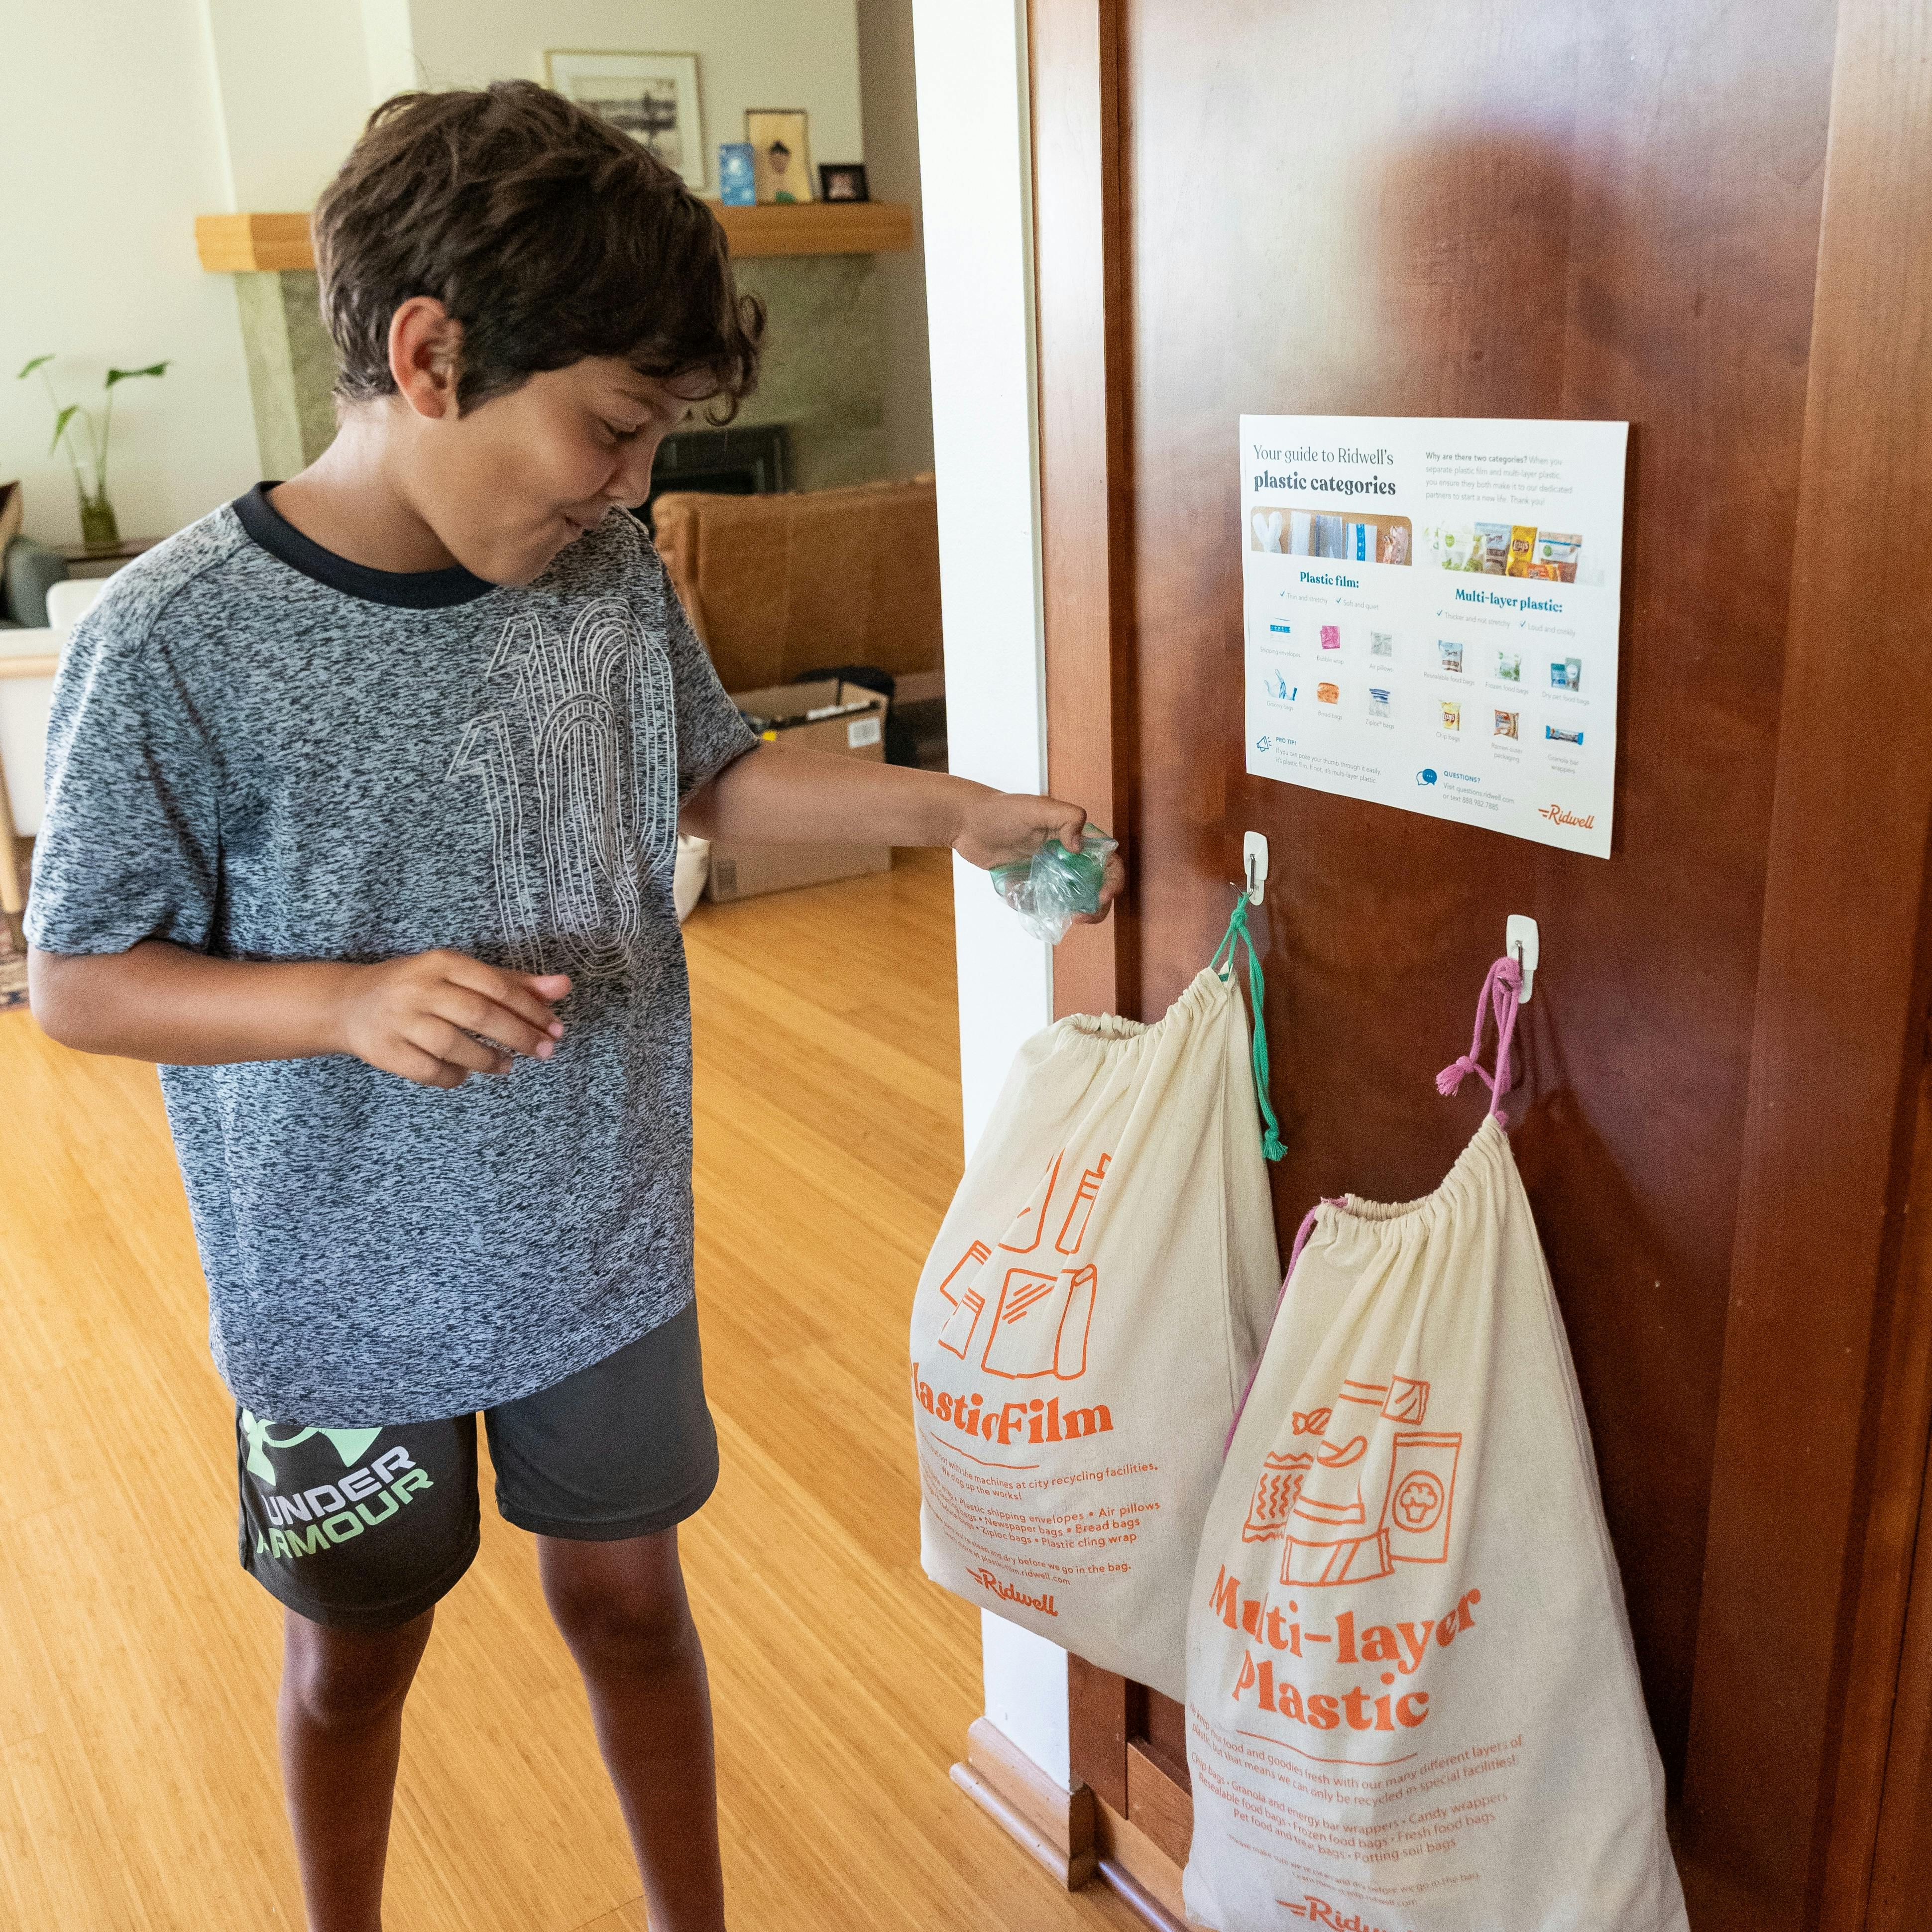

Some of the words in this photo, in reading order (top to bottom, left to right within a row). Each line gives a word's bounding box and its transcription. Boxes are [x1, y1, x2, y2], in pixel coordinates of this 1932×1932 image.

[1253, 445, 1281, 459] Your
[1285, 447, 1318, 463] guide
[1322, 450, 1334, 462] to
[1339, 448, 1393, 465] Ridwell's
[1426, 452, 1440, 461] Why
[1489, 456, 1527, 464] categories?
[1254, 470, 1307, 491] plastic
[1311, 475, 1396, 495] categories
[1300, 571, 1333, 585] Plastic
[1336, 575, 1359, 588] film:
[1456, 588, 1518, 608] Multi-layer
[1520, 597, 1563, 612] plastic:
[1324, 758, 1339, 766] thumb
[1444, 771, 1480, 783] QUESTIONS?
[1548, 804, 1594, 829] Ridwell
[913, 1362, 1001, 1441] lastic
[997, 1396, 1114, 1445] Film
[263, 1446, 416, 1526] UNDER
[949, 1461, 961, 1474] with
[962, 1469, 972, 1479] the
[975, 1477, 1013, 1489] machines
[1029, 1479, 1048, 1489] city
[1051, 1472, 1103, 1484] recycling
[1105, 1464, 1158, 1477] facilities.
[951, 1475, 964, 1488] clog
[977, 1486, 990, 1495] the
[993, 1489, 1022, 1500] works!
[960, 1498, 984, 1513] Plastic
[987, 1507, 1025, 1522] shipping
[1029, 1512, 1084, 1524] envelopes
[1099, 1508, 1115, 1517] Air
[1120, 1502, 1160, 1517] pillows
[981, 1526, 1007, 1540] Ziploc
[1010, 1533, 1032, 1545] bags
[1041, 1537, 1074, 1548] Plastic
[1078, 1536, 1105, 1547] cling
[1108, 1533, 1137, 1544] wrap
[985, 1517, 1035, 1533] Newspaper
[1038, 1525, 1063, 1537] bags
[1075, 1520, 1109, 1533] Bread
[1113, 1518, 1140, 1529] bags
[1004, 1554, 1016, 1564] dry
[1018, 1557, 1046, 1568] before
[1062, 1565, 1073, 1575] go
[1088, 1564, 1105, 1573] the
[1108, 1563, 1131, 1572] bag.
[978, 1568, 1058, 1616] Ridwell
[1232, 1649, 1430, 1731] Plastic
[1223, 1737, 1244, 1753] food
[1247, 1749, 1265, 1760] and
[1268, 1755, 1302, 1776] goodies
[1305, 1769, 1330, 1785] fresh
[1334, 1776, 1359, 1789] with
[1362, 1781, 1381, 1790] our
[1386, 1771, 1417, 1786] many
[1420, 1755, 1469, 1775] different
[1473, 1743, 1507, 1759] layers
[1510, 1733, 1522, 1748] of
[1225, 1752, 1242, 1766] that
[1245, 1762, 1275, 1779] means
[1278, 1773, 1290, 1784] we
[1293, 1782, 1308, 1792] can
[1311, 1789, 1333, 1803] only
[1337, 1789, 1351, 1803] be
[1354, 1789, 1403, 1807] recycled
[1420, 1771, 1460, 1791] special
[1192, 1752, 1207, 1771] Chip
[1208, 1765, 1225, 1785] bags
[1232, 1780, 1265, 1803] Granola
[1268, 1799, 1285, 1812] and
[1288, 1807, 1319, 1827] energy
[1322, 1819, 1339, 1831] bar
[1343, 1820, 1398, 1836] wrappers
[1409, 1808, 1447, 1822] Candy
[1452, 1793, 1508, 1814] wrappers
[1199, 1772, 1240, 1805] Resealable
[1243, 1798, 1262, 1815] food
[1265, 1808, 1285, 1825] bags
[1293, 1821, 1326, 1840] Frozen
[1329, 1835, 1355, 1847] food
[1359, 1838, 1387, 1850] bags
[1398, 1827, 1432, 1841] Fresh
[1434, 1819, 1462, 1834] food
[1466, 1813, 1495, 1825] bags
[1234, 1808, 1248, 1822] Pet
[1251, 1816, 1272, 1832] food
[1275, 1829, 1292, 1840] and
[1318, 1844, 1344, 1859] bags
[1354, 1850, 1400, 1863] Potting
[1403, 1845, 1423, 1856] soil
[1426, 1839, 1456, 1854] bags
